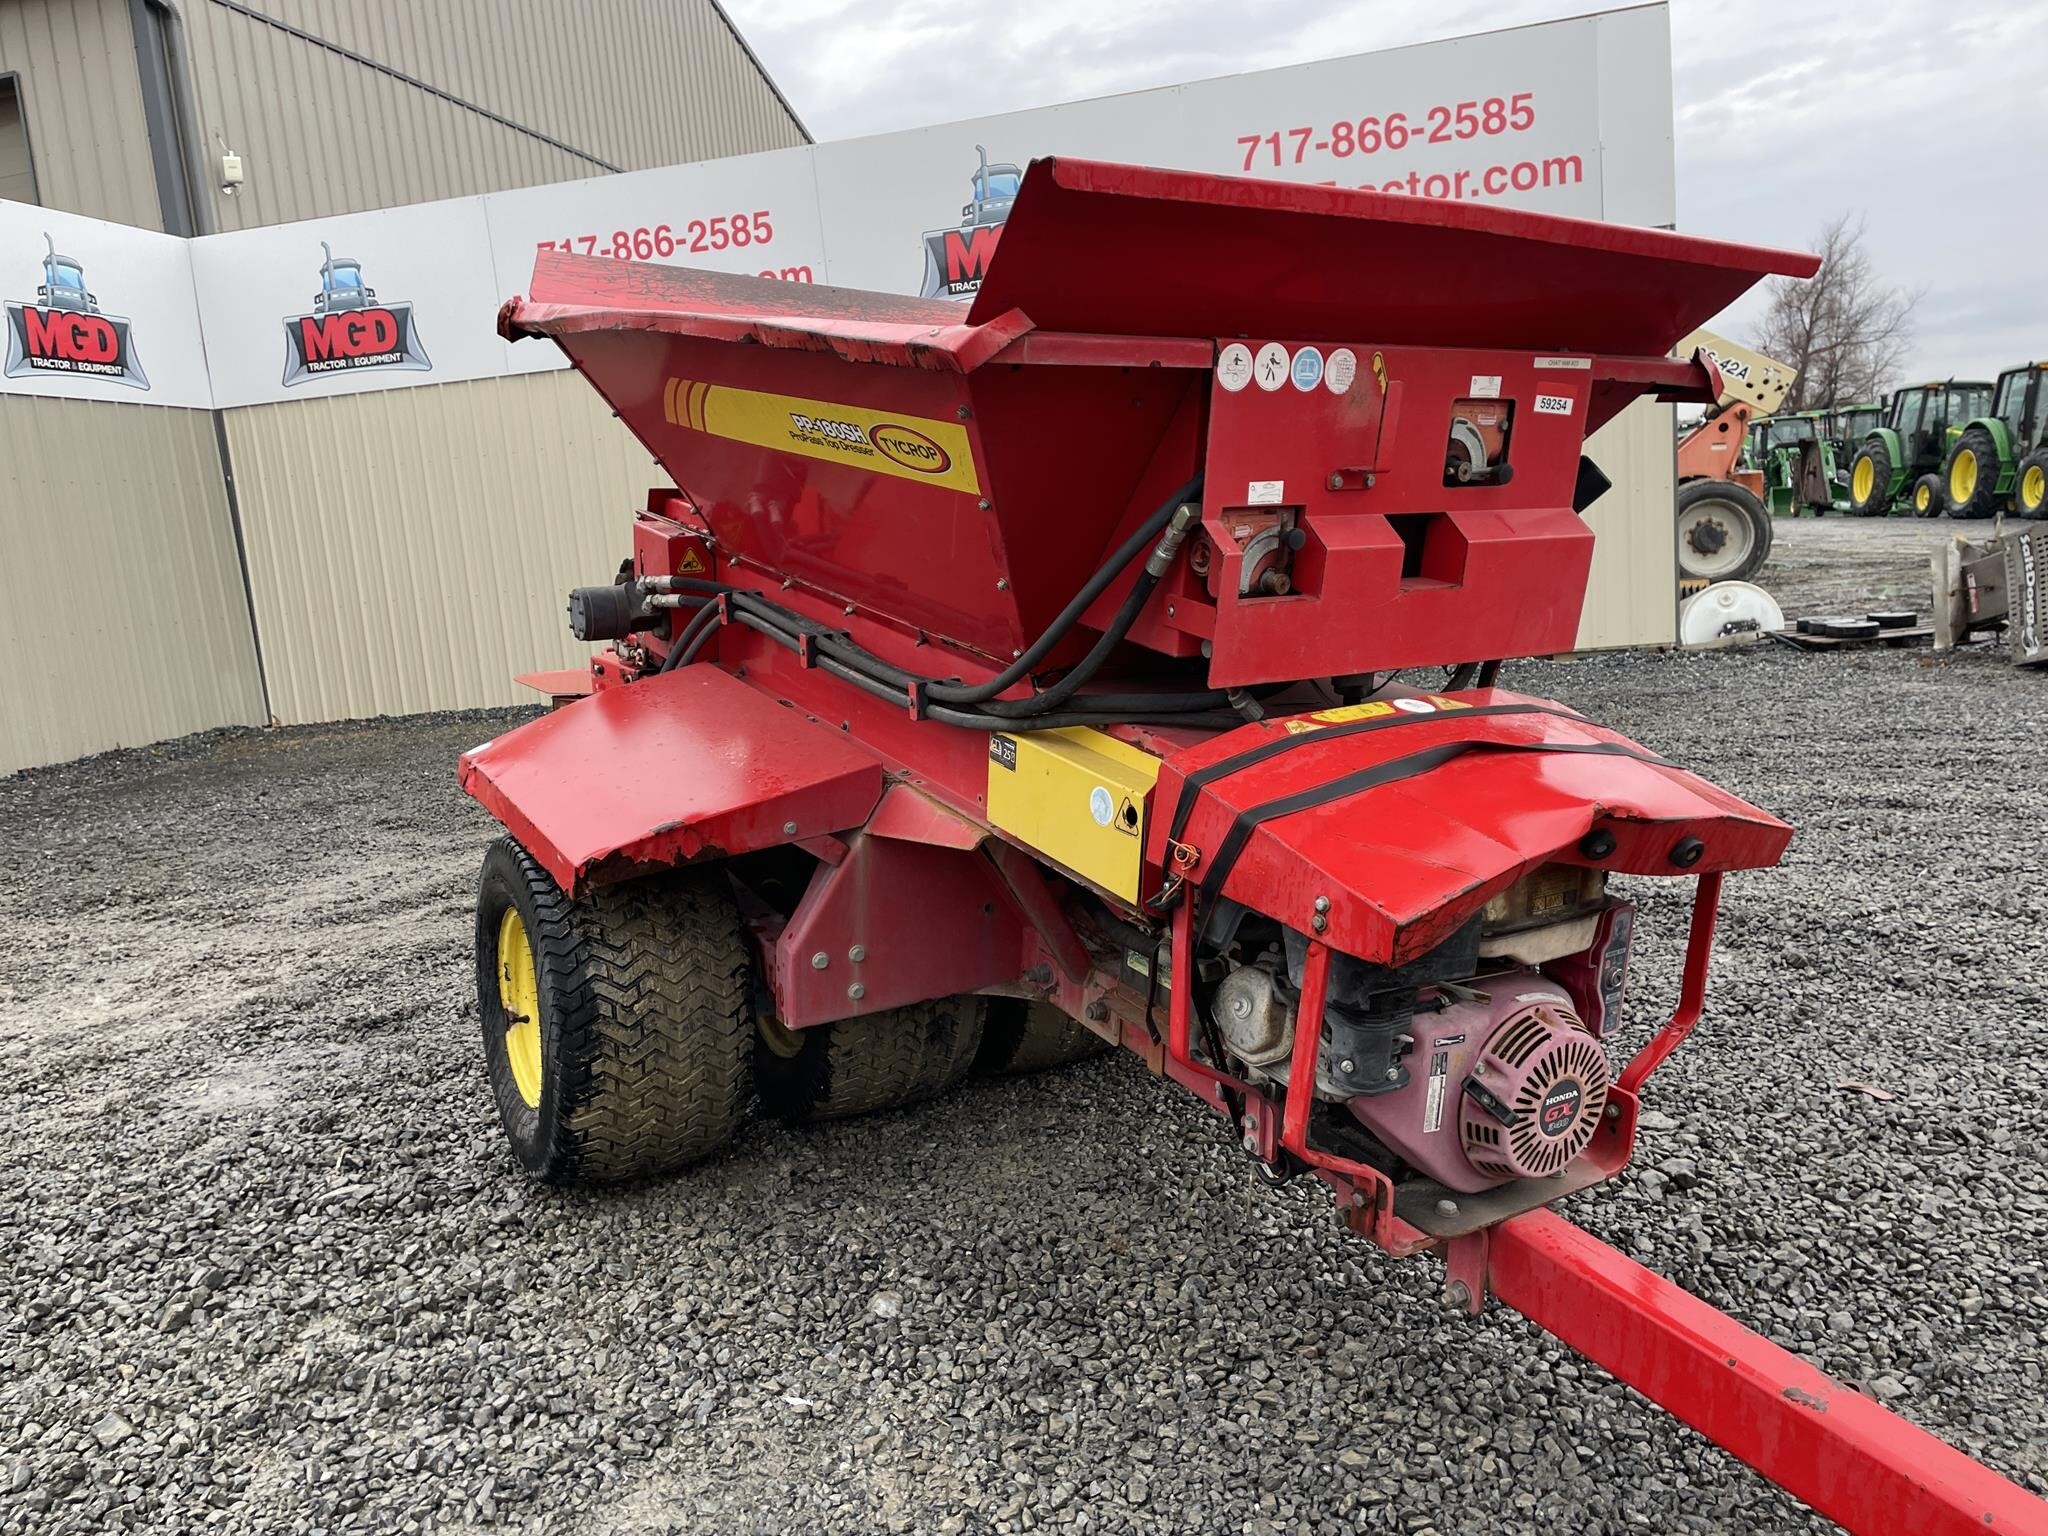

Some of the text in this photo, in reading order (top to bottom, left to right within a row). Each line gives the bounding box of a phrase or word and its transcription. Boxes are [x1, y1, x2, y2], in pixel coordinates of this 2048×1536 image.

[1237, 92, 1536, 171] 717-866-2585
[1314, 153, 1584, 200] tor.com
[944, 224, 1005, 281] M
[23, 306, 119, 363] MGD
[300, 308, 398, 361] MGD
[31, 357, 71, 370] TRACTOR
[79, 362, 123, 375] EQUIPMENT
[308, 359, 347, 371] TRACTOR
[354, 353, 402, 366] EQUIPMENT
[1540, 397, 1568, 411] 59254
[790, 413, 869, 445] PP-180SH
[788, 431, 875, 457] ProPass Top Dresser
[879, 436, 938, 461] TYCROP
[1545, 1090, 1579, 1106] HONDA
[1544, 1101, 1575, 1122] GX
